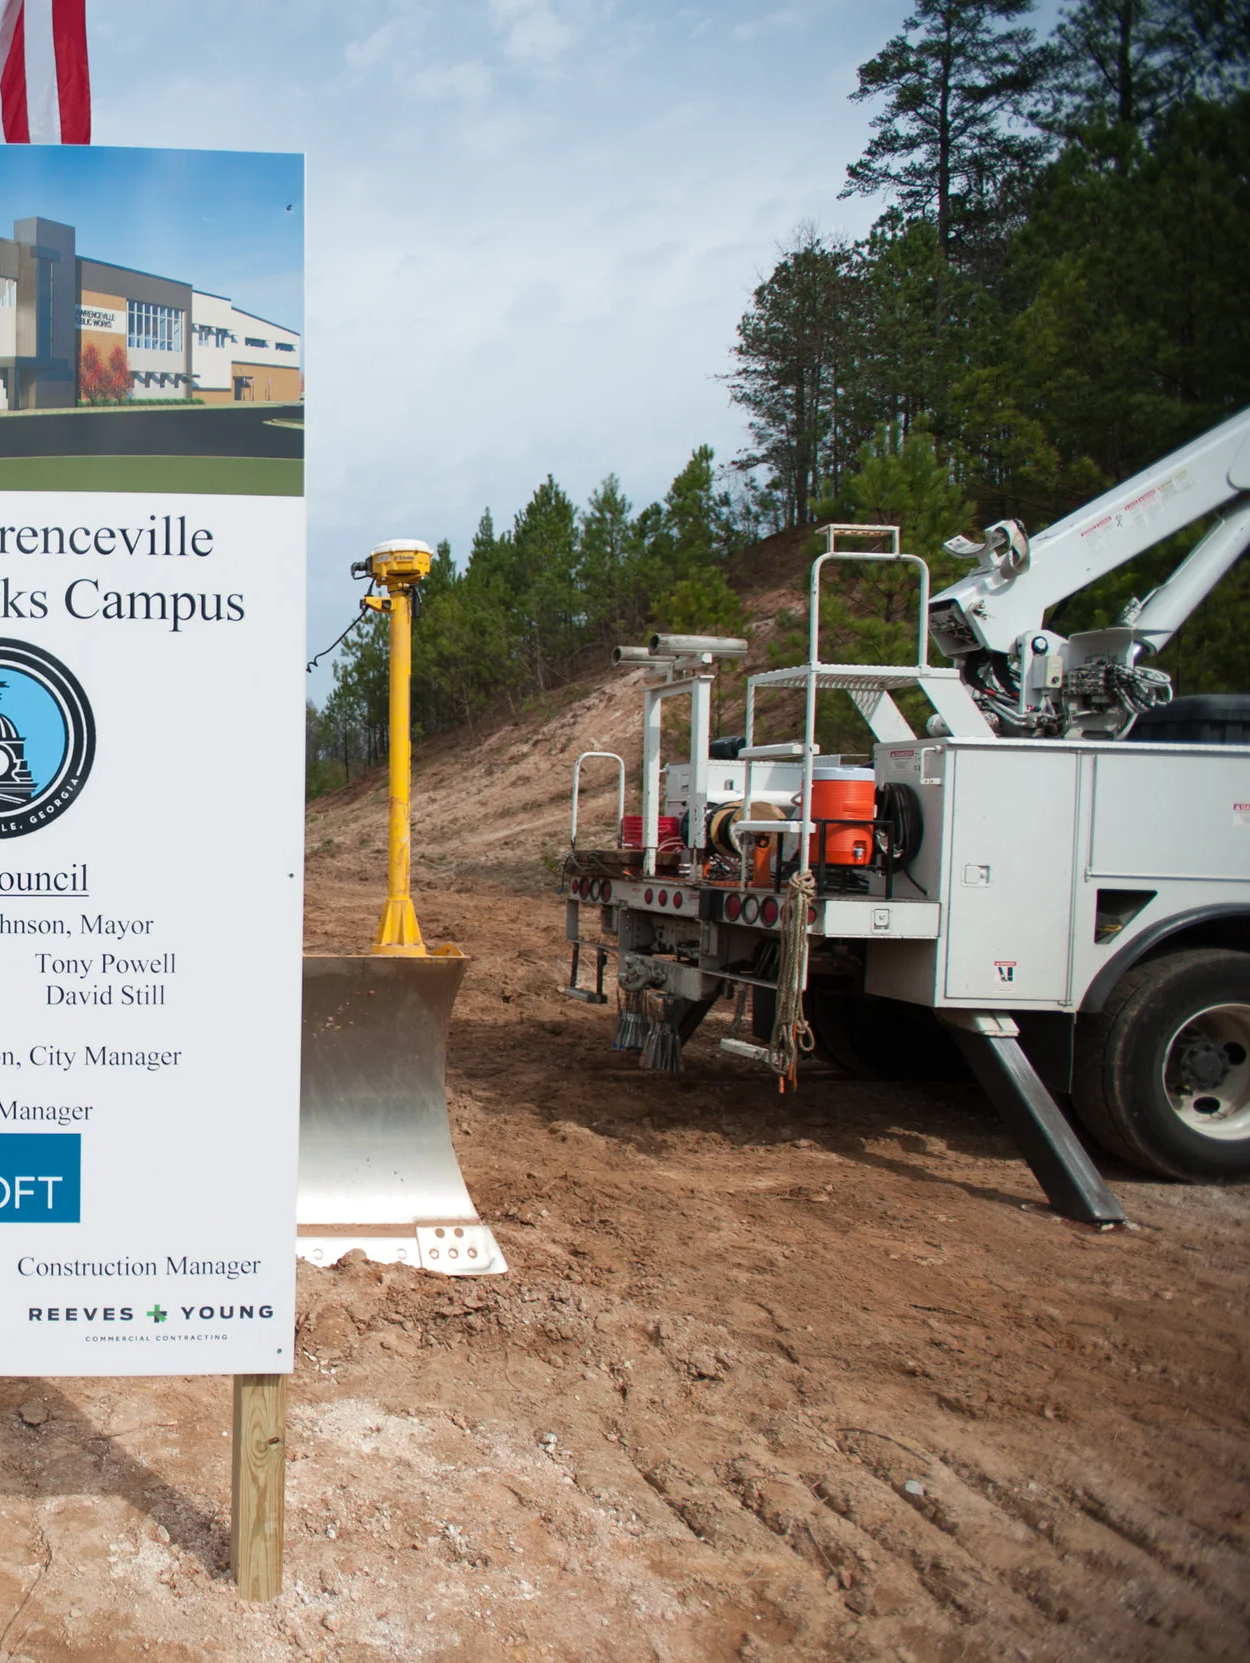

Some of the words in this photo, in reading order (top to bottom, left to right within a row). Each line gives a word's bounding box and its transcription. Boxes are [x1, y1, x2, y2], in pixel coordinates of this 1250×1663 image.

[64, 578, 246, 633] Campus
[29, 777, 80, 825] GEORGIA
[80, 914, 155, 940] Mayor
[34, 953, 93, 979] Tony
[101, 953, 176, 974] Powell
[46, 985, 113, 1006] David
[121, 985, 165, 1006] Still
[29, 1045, 77, 1071] City
[85, 1045, 183, 1072] Manager
[17, 1255, 158, 1278] Construction
[166, 1255, 262, 1280] Manager
[28, 1306, 134, 1322] REEVES
[180, 1304, 274, 1321] YOUNG
[85, 1335, 151, 1343] COMMERCIAL
[155, 1334, 228, 1342] CONTRACTING
